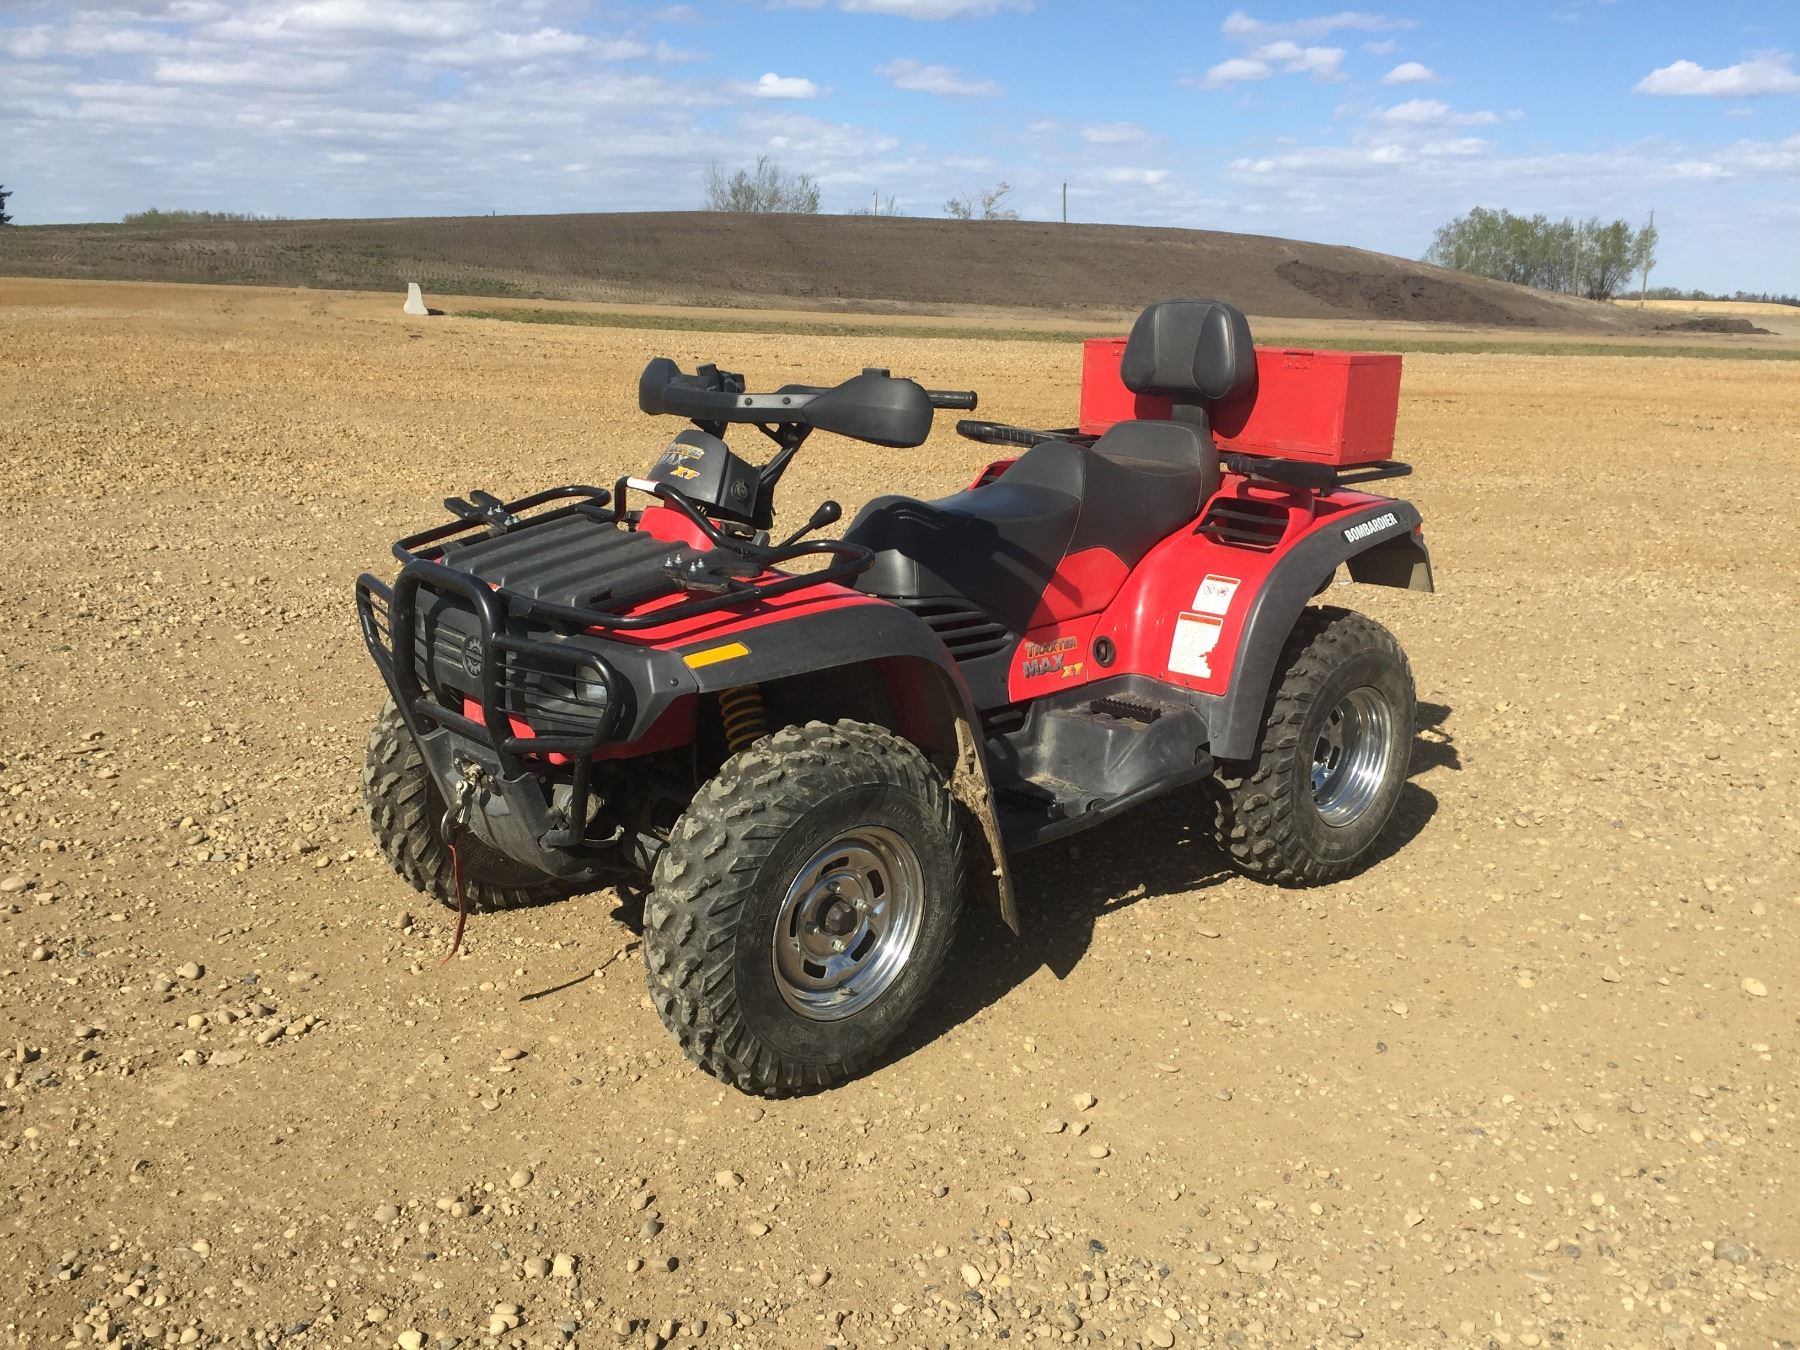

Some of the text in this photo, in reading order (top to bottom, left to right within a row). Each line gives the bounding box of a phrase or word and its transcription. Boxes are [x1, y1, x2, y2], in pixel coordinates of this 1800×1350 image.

[1344, 512, 1398, 543] BOMBARDIER
[1023, 654, 1083, 678] MAX XT
